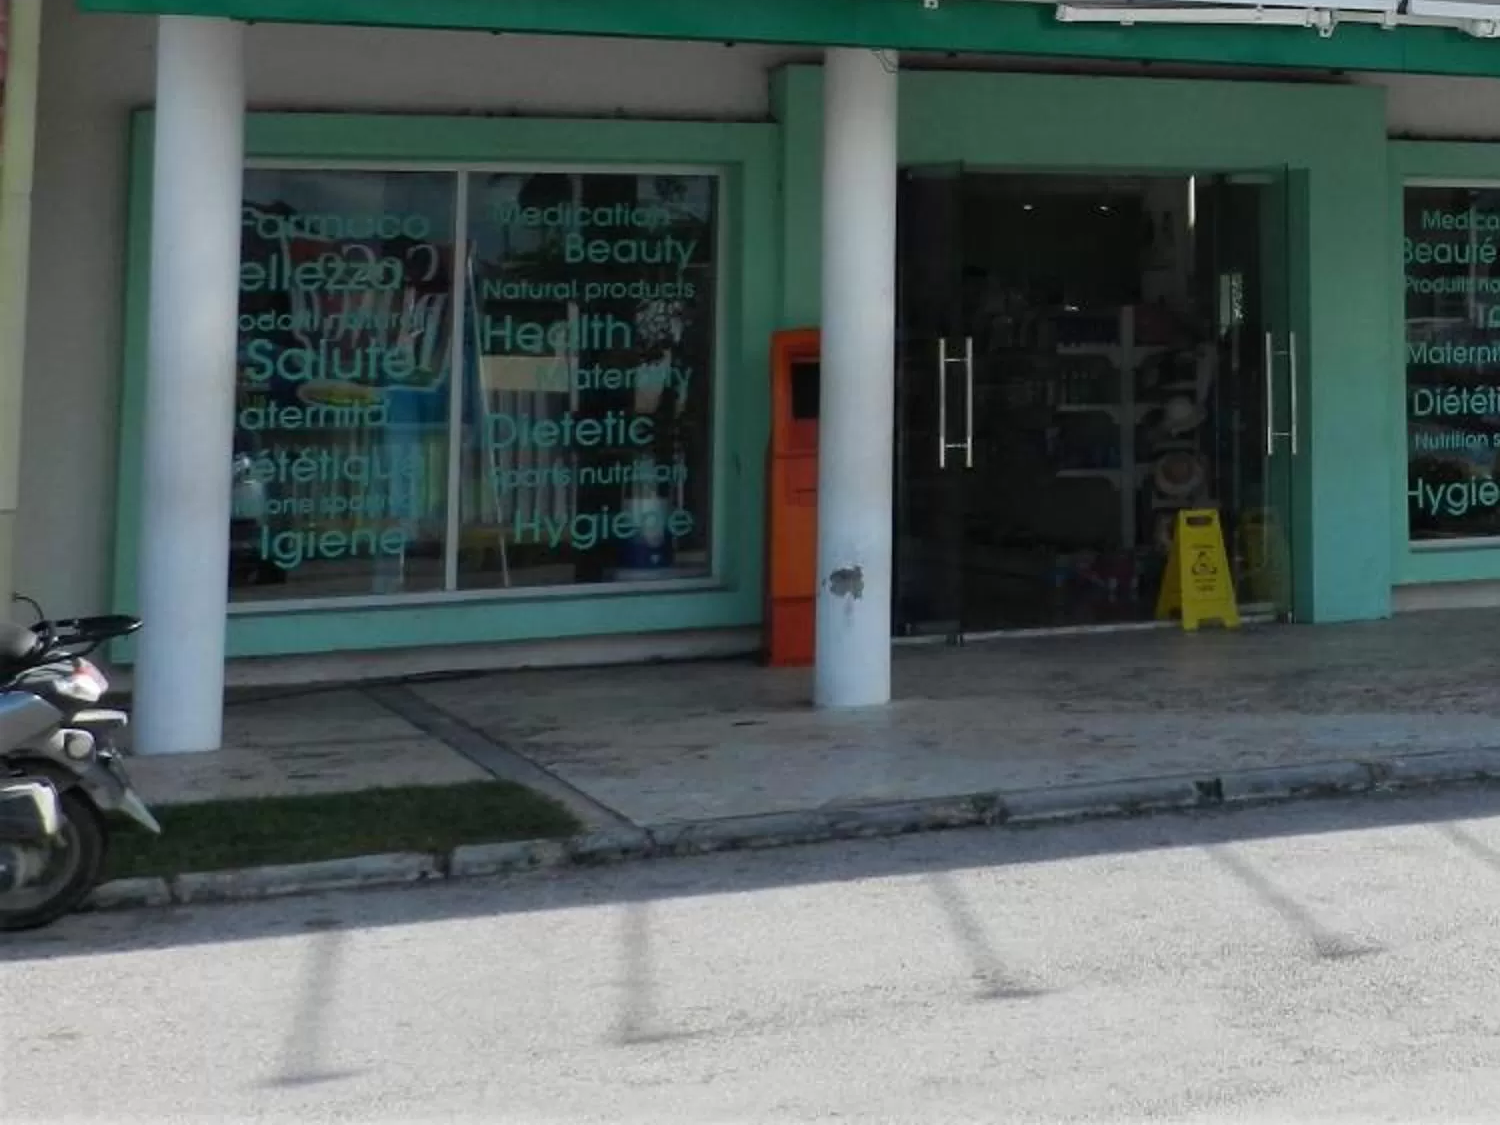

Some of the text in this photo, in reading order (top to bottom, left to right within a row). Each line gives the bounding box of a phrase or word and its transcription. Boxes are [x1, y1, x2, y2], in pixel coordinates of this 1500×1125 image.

[564, 232, 698, 277] Beauty
[482, 278, 697, 302] Natural products
[483, 314, 633, 352] Health
[243, 338, 416, 381] Salute
[484, 410, 655, 448] Dietetic
[260, 524, 408, 569] Igiene
